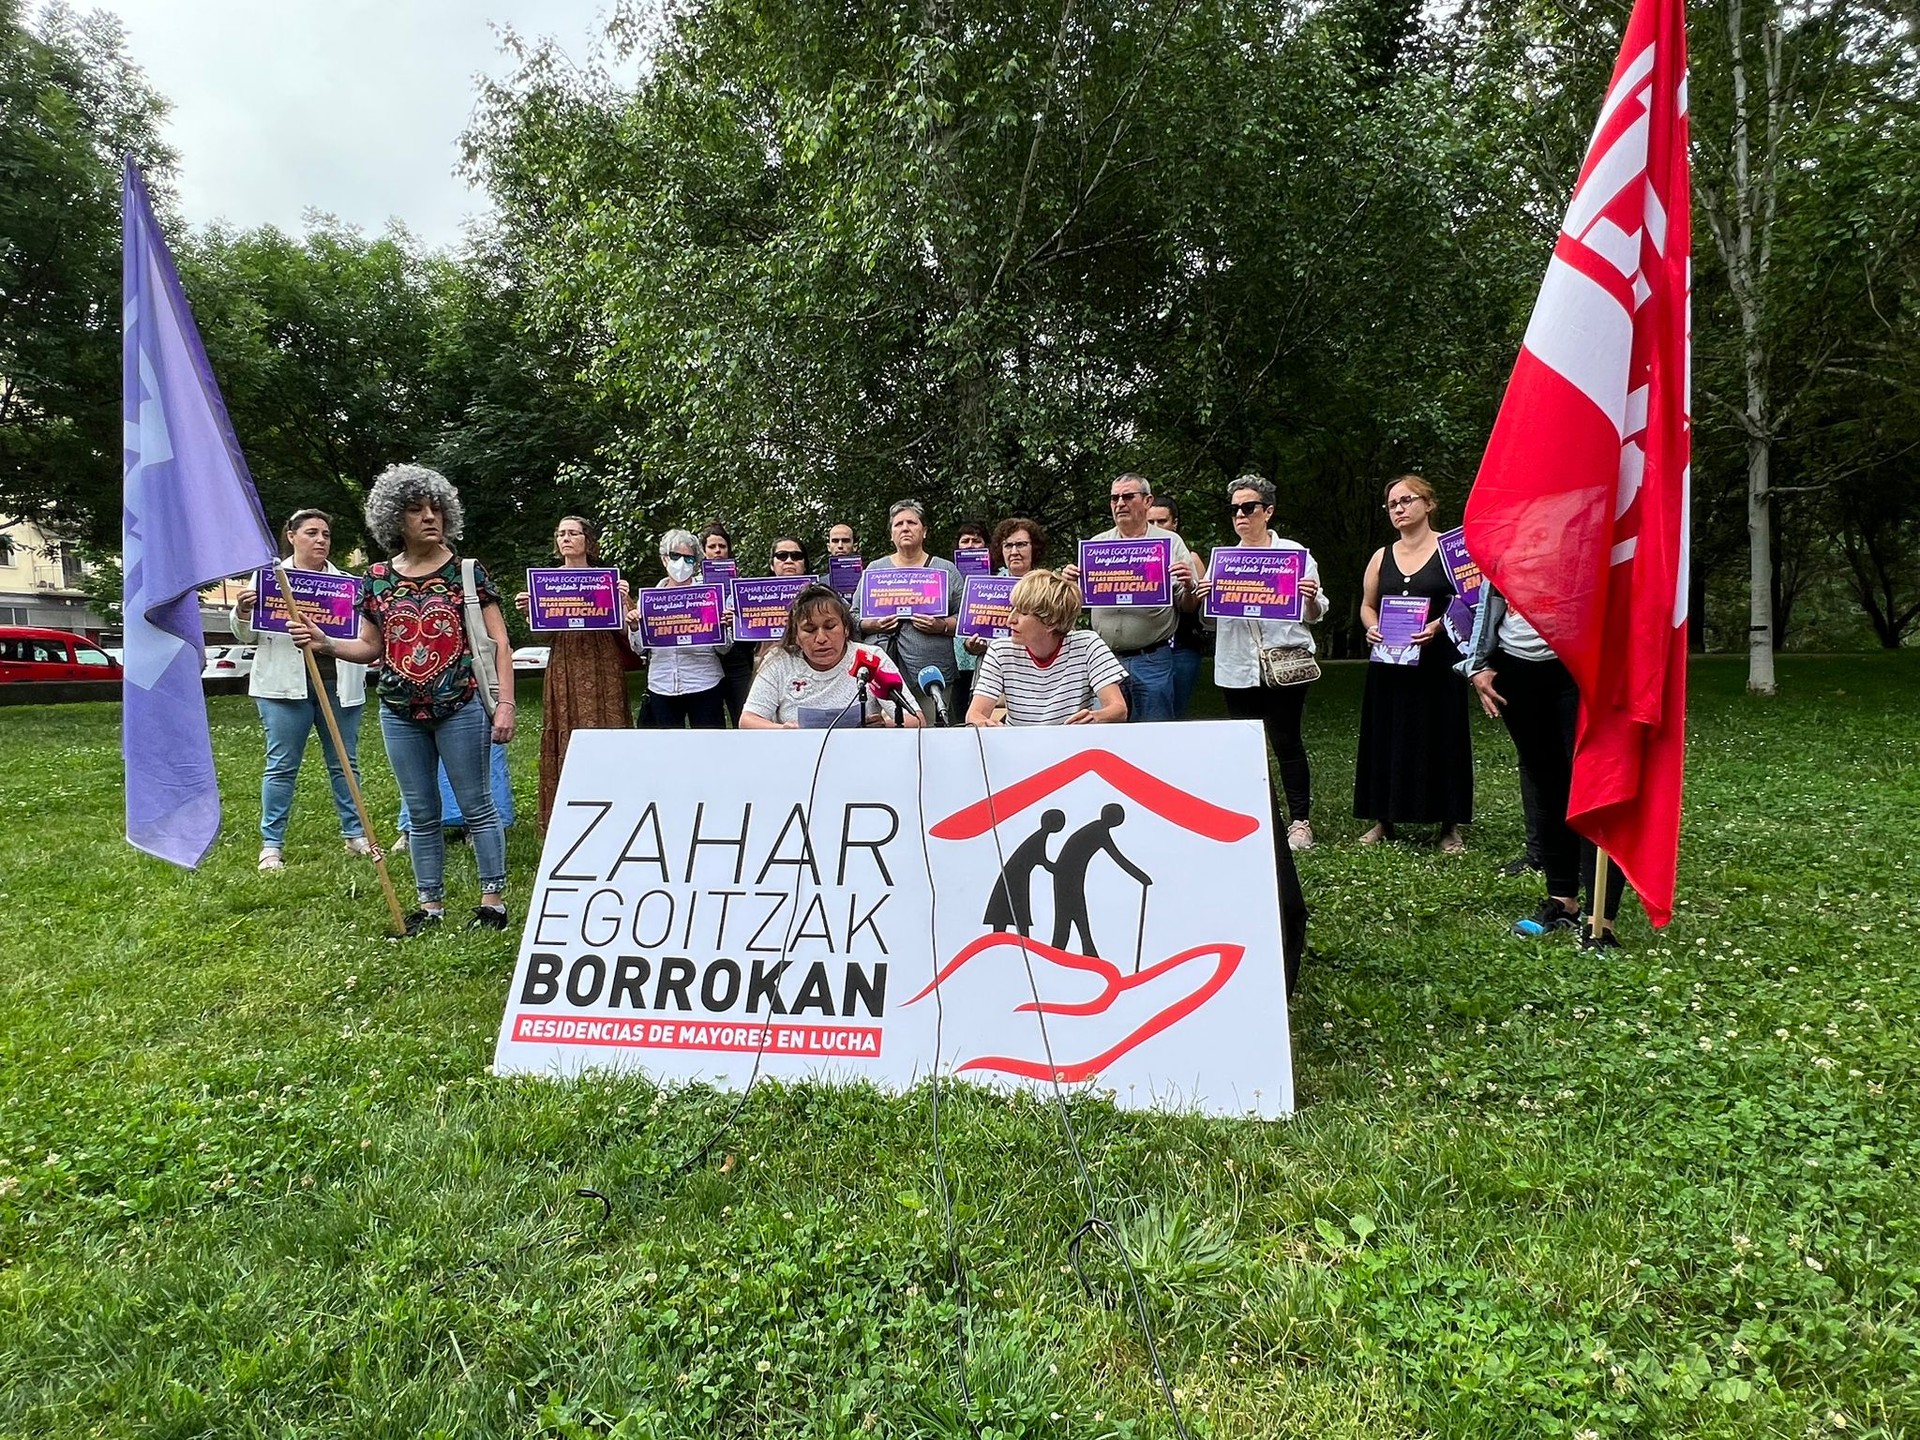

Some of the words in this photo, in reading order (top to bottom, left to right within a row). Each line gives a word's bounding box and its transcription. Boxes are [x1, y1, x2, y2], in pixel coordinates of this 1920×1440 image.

[1113, 582, 1158, 592] LUCHA!
[1242, 593, 1290, 605] LUCHA!
[566, 608, 609, 617] LUCHA!
[768, 617, 789, 626] LUC
[549, 801, 900, 887] ZAHAR
[534, 888, 892, 954] EGOITZAK
[520, 953, 888, 1018] BORROKAN
[519, 1019, 644, 1042] RESIDENCIAS
[648, 1025, 675, 1043] DE
[678, 1026, 772, 1047] MAYORES
[777, 1030, 805, 1049] EN
[810, 1031, 877, 1051] LUCHA
